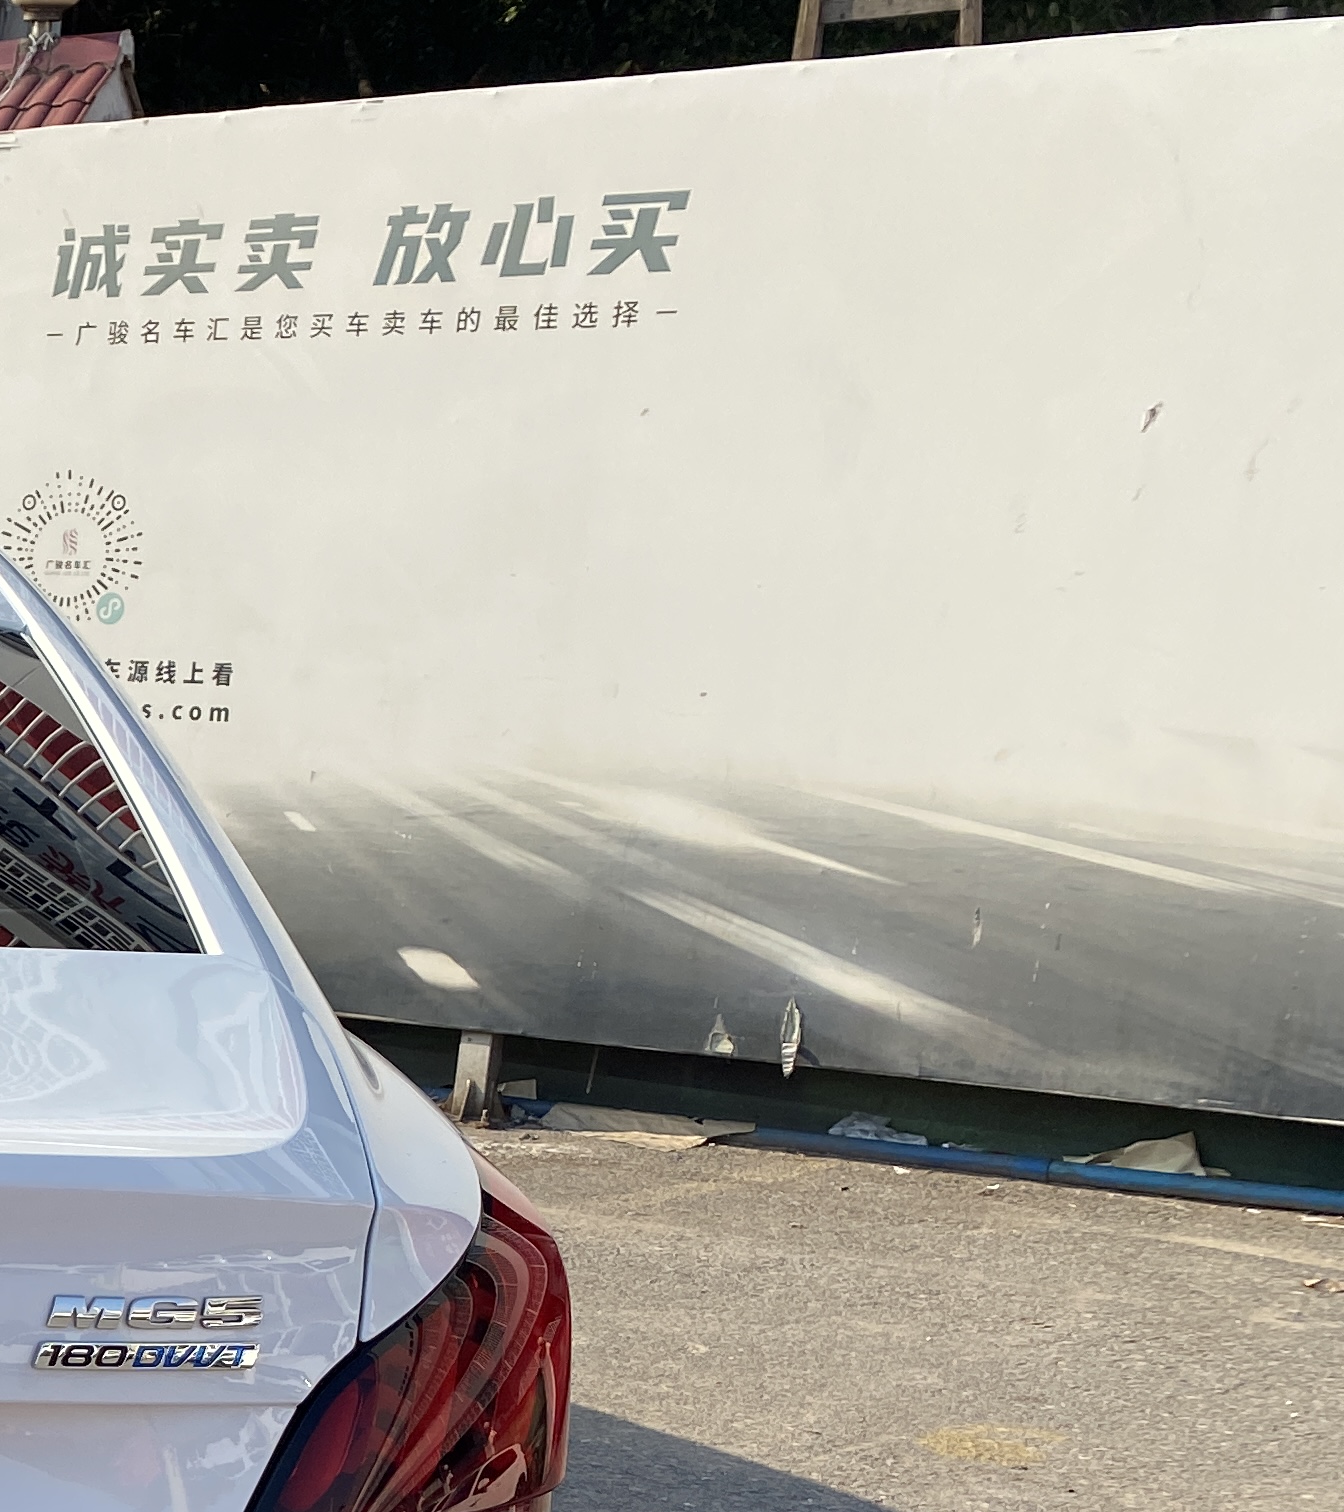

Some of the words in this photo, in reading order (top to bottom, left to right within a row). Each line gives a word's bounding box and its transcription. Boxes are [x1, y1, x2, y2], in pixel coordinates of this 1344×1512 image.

[52, 213, 320, 300] 诚实卖
[372, 189, 692, 286] 放心买
[45, 559, 92, 571] 广骏名车汇
[46, 1294, 263, 1330] MG5
